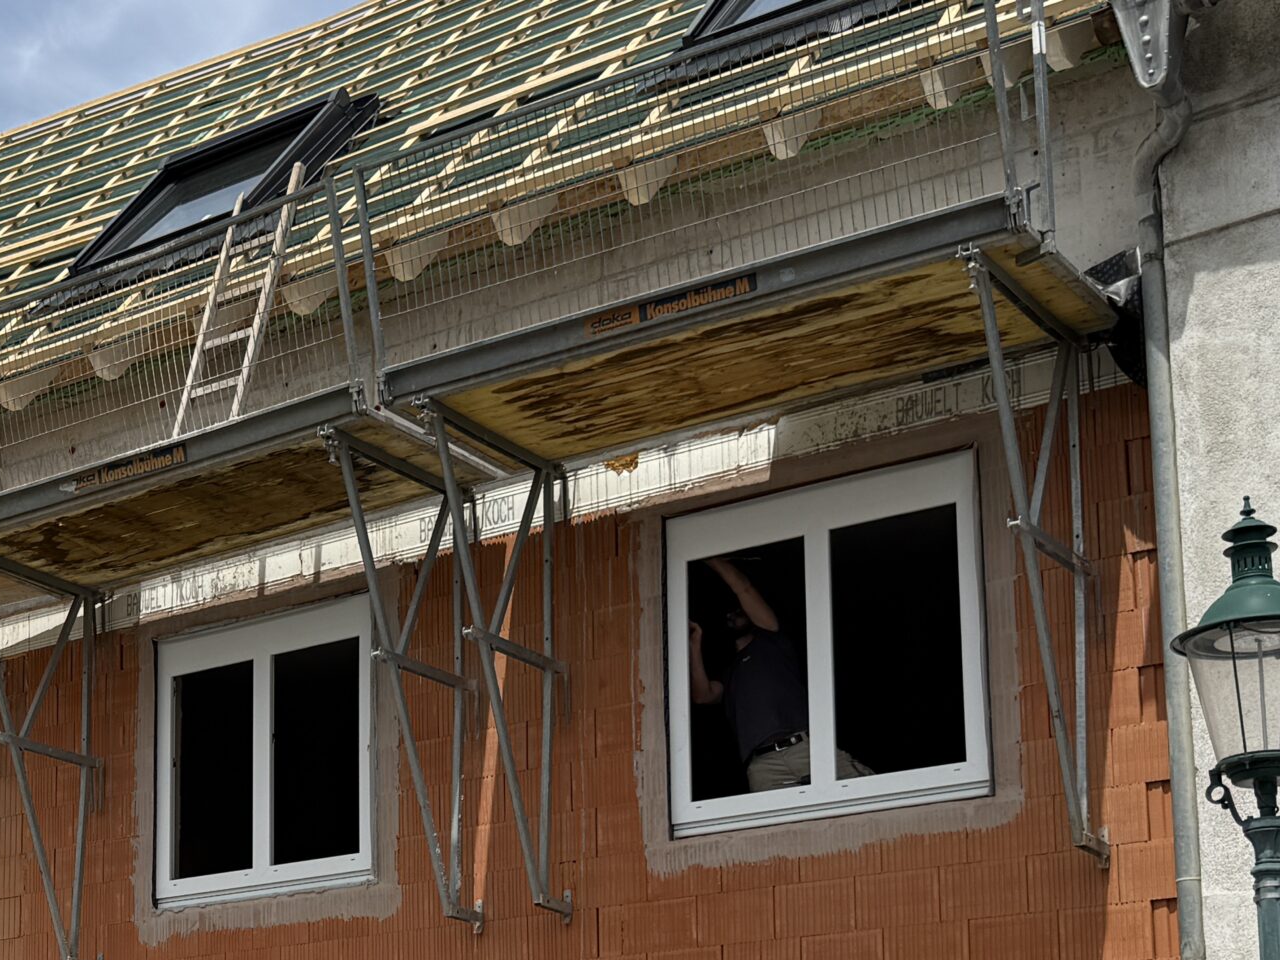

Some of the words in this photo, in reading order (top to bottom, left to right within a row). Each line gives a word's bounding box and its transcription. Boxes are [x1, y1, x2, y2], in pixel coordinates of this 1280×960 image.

[646, 286, 735, 321] Konsolbühne
[736, 277, 750, 295] M
[590, 311, 633, 330] doka
[895, 382, 962, 425] BAUWELT
[101, 454, 173, 483] Konsolbühne
[173, 447, 185, 464] M
[485, 495, 515, 528] KOCH
